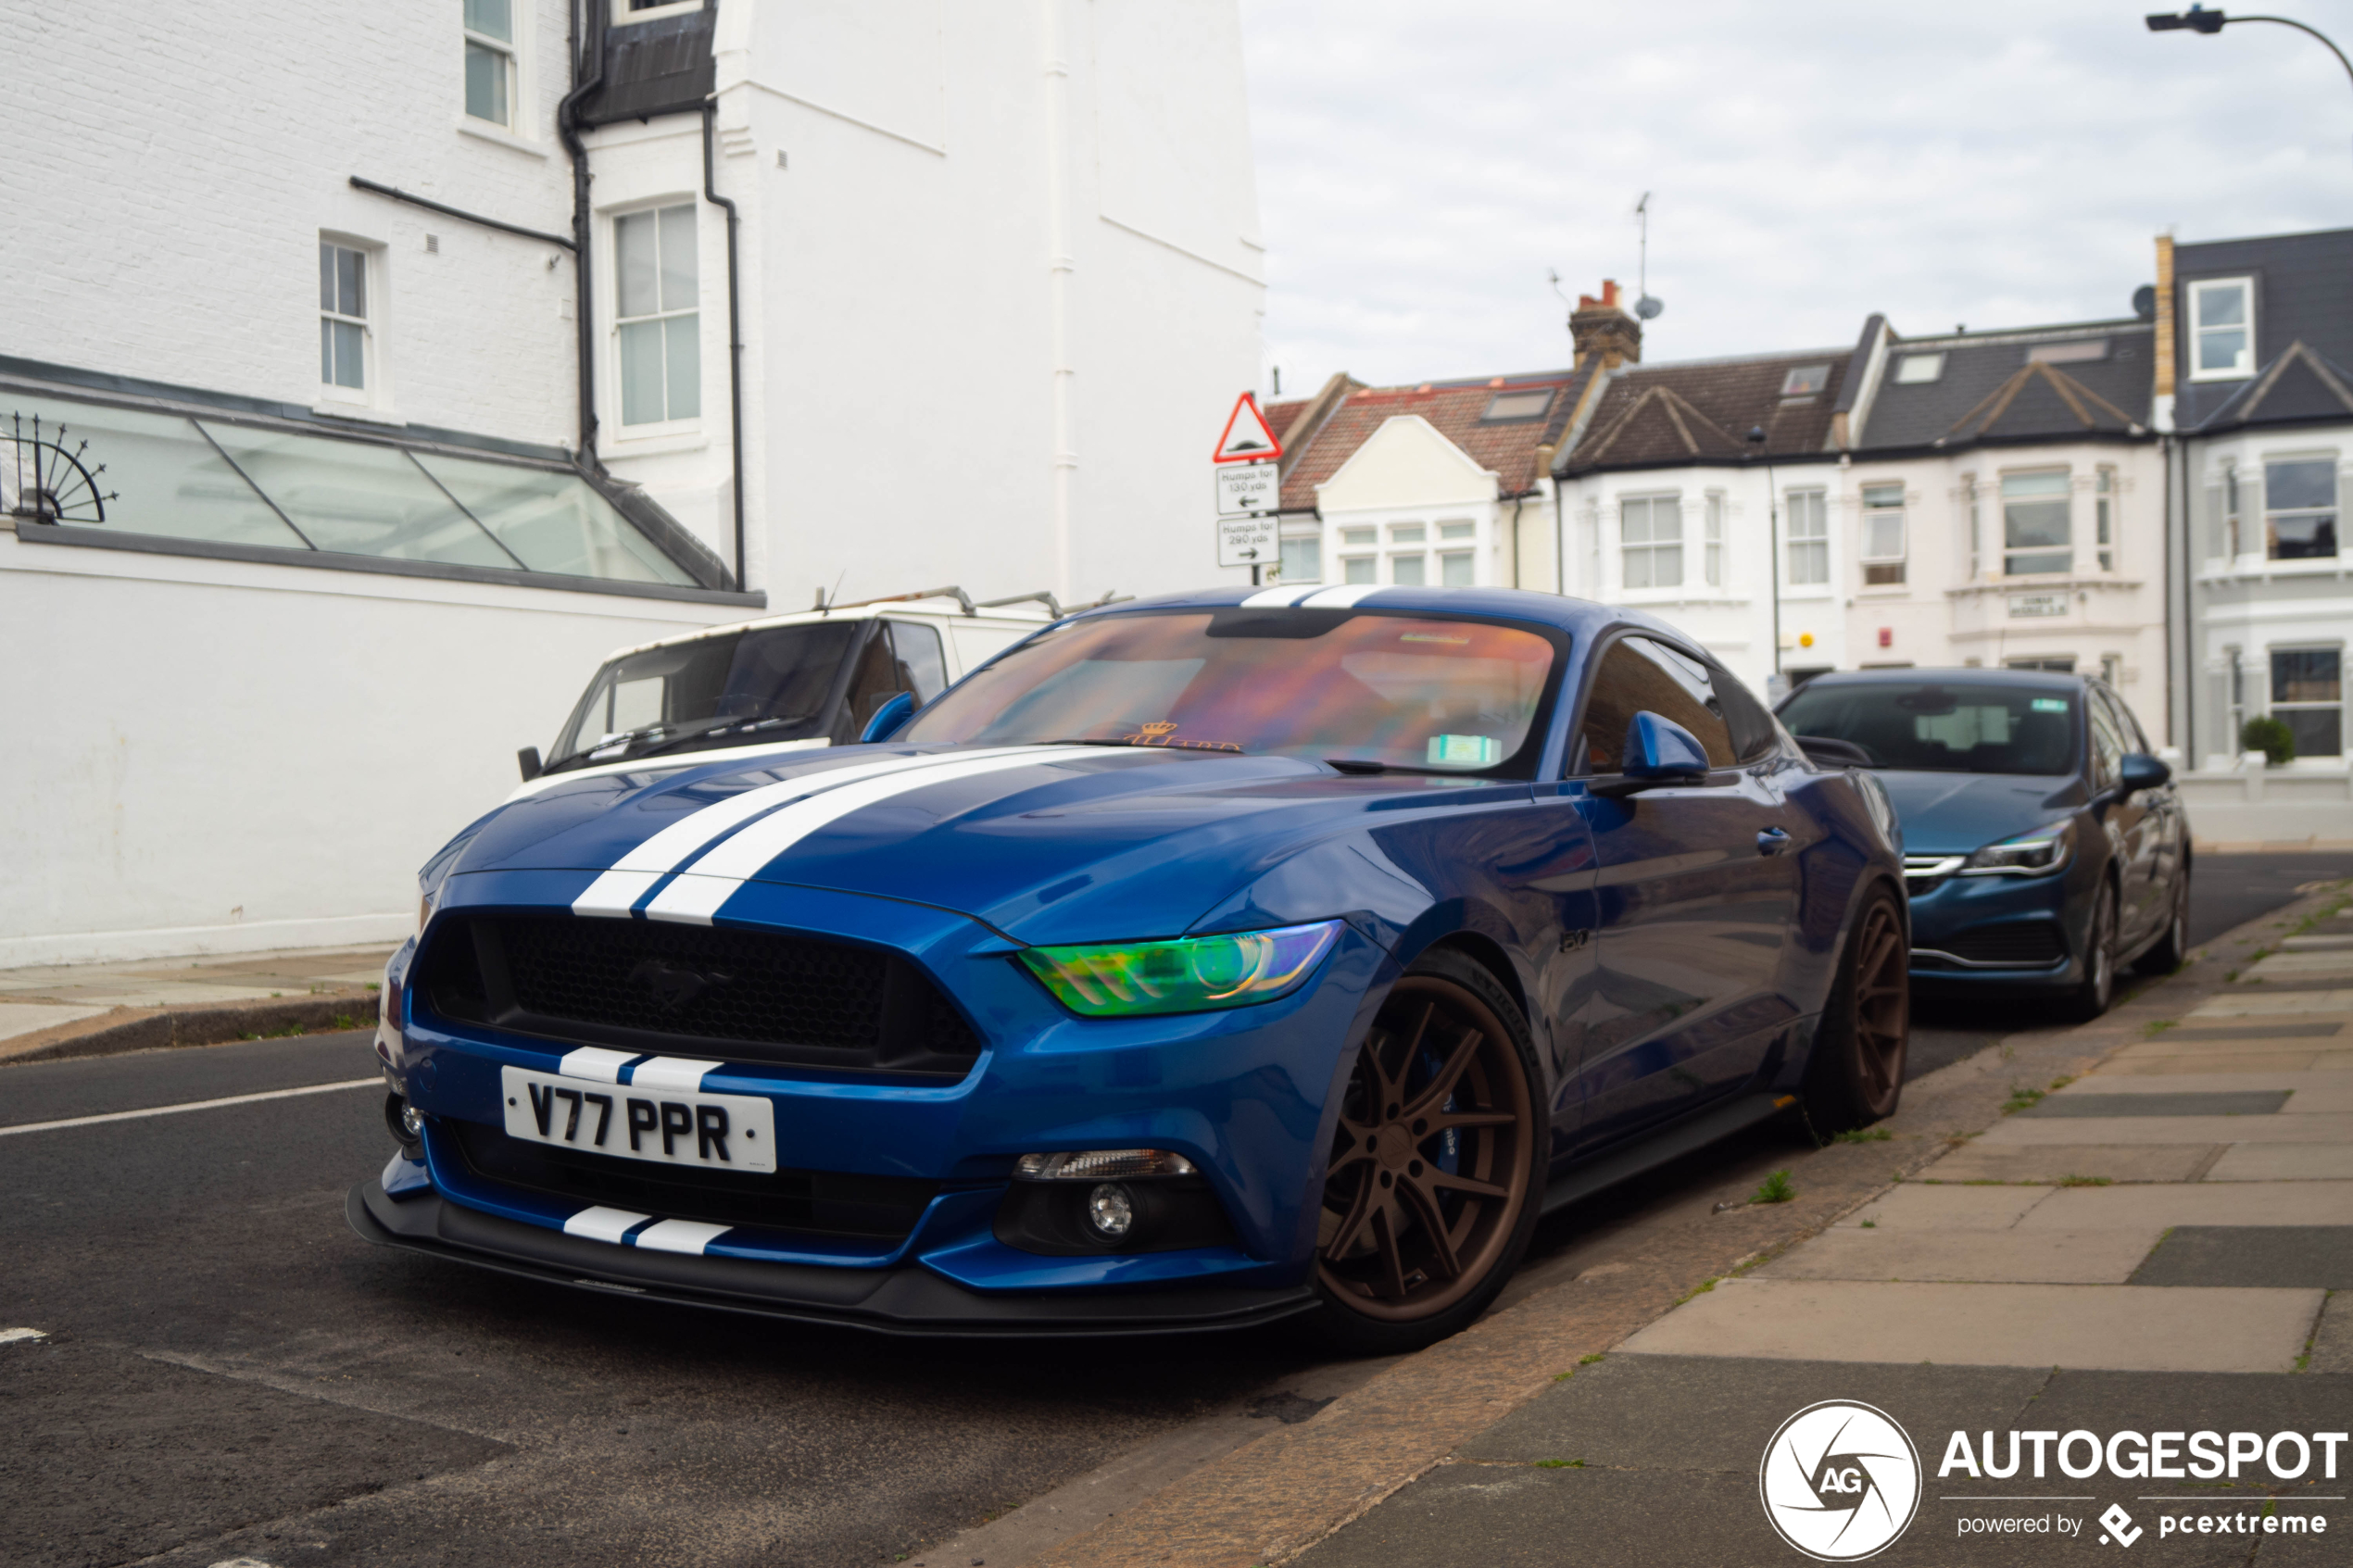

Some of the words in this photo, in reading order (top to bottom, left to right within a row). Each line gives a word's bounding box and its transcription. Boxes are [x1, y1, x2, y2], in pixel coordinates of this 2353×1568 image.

[1222, 471, 1256, 482] Humps
[1260, 470, 1273, 478] for
[1229, 483, 1248, 492] 130
[1250, 481, 1267, 492] yds
[1223, 523, 1257, 533] Humps
[1260, 521, 1274, 531] for
[1251, 533, 1269, 545] yds
[527, 1082, 613, 1147] V77
[626, 1098, 731, 1161] PPR
[1442, 1104, 1456, 1156] bmbo
